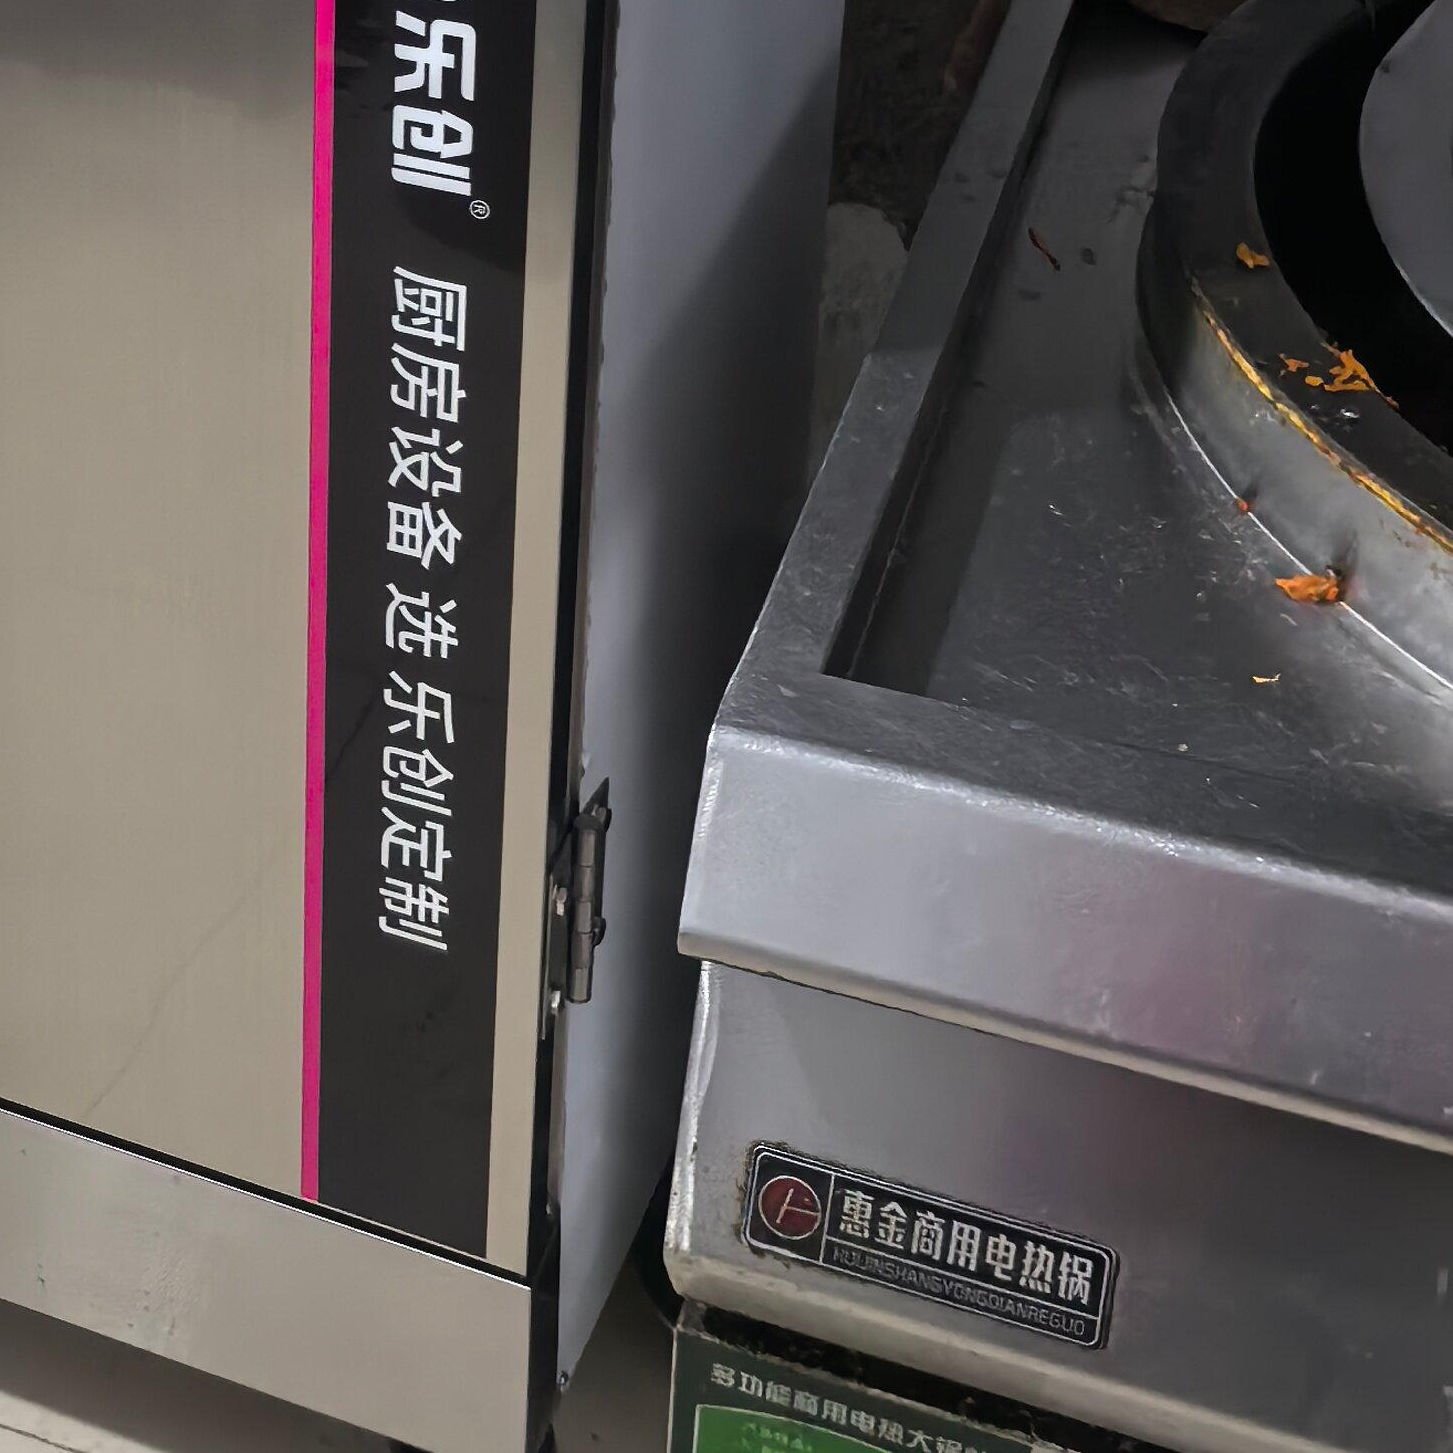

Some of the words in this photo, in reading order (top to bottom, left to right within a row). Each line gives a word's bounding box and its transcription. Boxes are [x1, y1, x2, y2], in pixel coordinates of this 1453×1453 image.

[385, 266, 468, 571] 厨房设备
[384, 582, 459, 661] 选
[378, 670, 455, 952] 乐创定制
[839, 1189, 1094, 1306] 惠金商用电热锅
